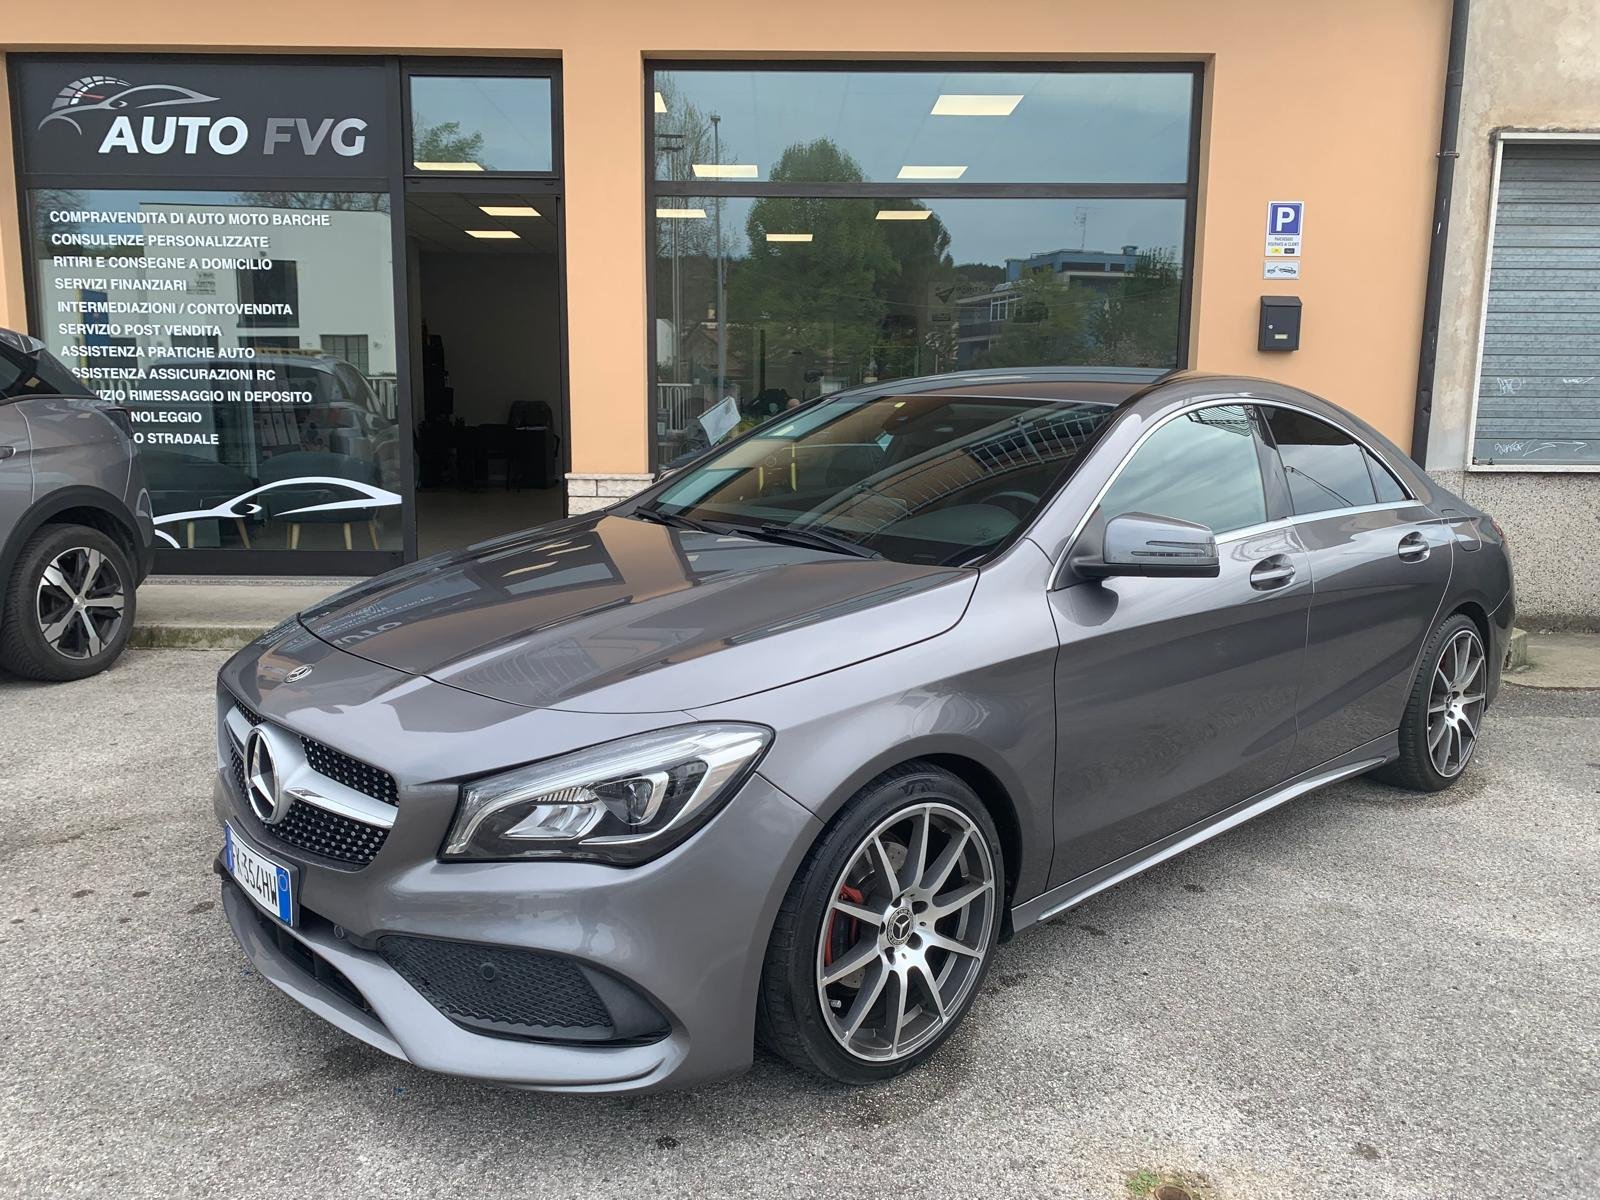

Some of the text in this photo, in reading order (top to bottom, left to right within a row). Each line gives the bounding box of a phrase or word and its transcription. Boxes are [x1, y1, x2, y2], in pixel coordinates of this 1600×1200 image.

[98, 116, 368, 157] AUTO FVG
[49, 211, 330, 226] COMPRAVENDITA DI AUTO MOTO BARCHE
[1275, 206, 1296, 232] P
[51, 233, 269, 248] CONSULENZE PERSONALIZZATE
[53, 256, 272, 270] RITIRI E CONSEGNE A DOMICILIO
[55, 278, 107, 290] SERVIZI
[110, 279, 187, 291] FINANZIARI
[57, 301, 293, 315] INTERMEDIAZIONI / CONTOVENDITA
[58, 323, 222, 336] SERVIZIO POST VENDITA
[61, 345, 255, 359] ASSISTENZA PRATICHE AUTO
[71, 367, 276, 381] SSISTENZA ASSICURAZIONI RC
[130, 390, 224, 401] RIMESSAGGIO
[227, 390, 240, 402] IN
[244, 391, 312, 402] DEPOSITO
[130, 411, 202, 423] NOLEGGIO
[147, 432, 219, 445] STRADALE
